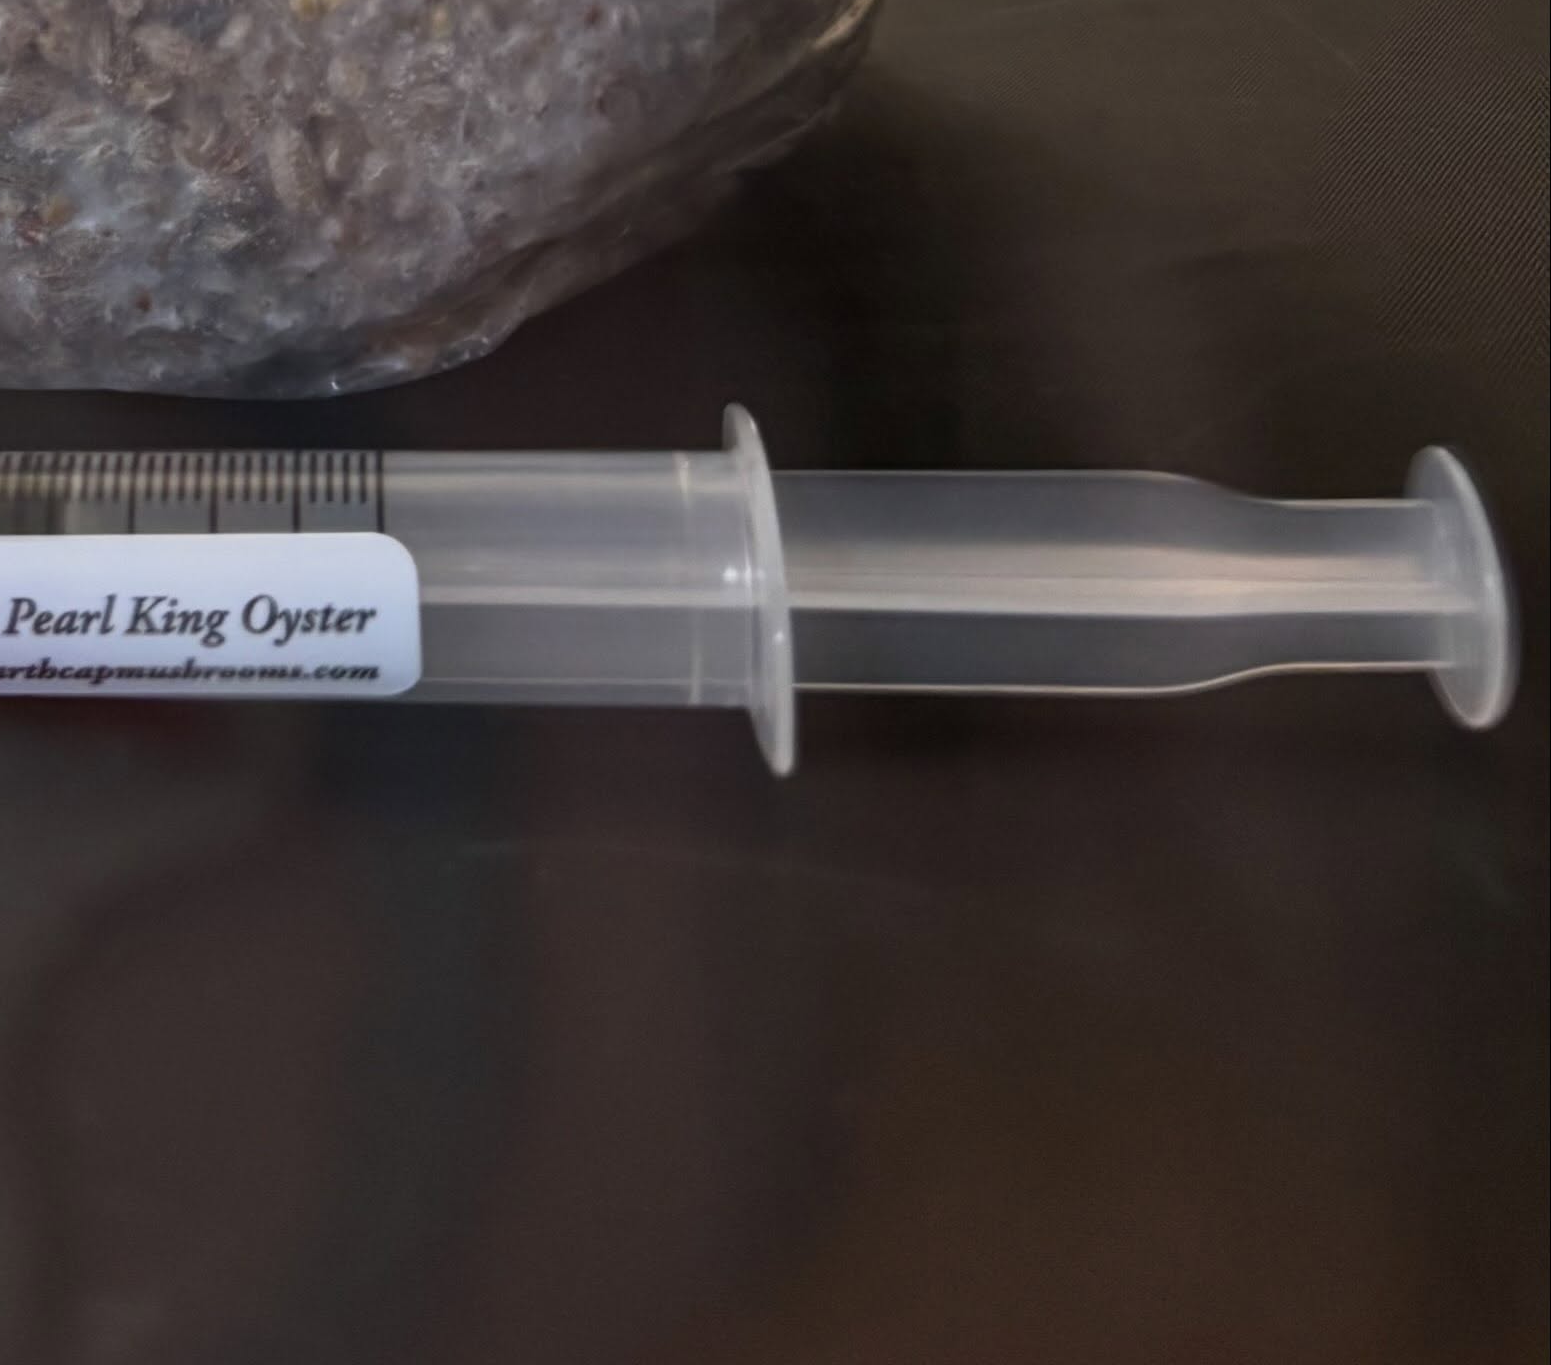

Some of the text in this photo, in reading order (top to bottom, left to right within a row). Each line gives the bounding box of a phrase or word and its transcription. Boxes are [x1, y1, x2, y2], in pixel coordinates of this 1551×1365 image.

[1, 593, 117, 636] Pearl
[124, 595, 230, 648] King
[241, 593, 377, 647] Oyster
